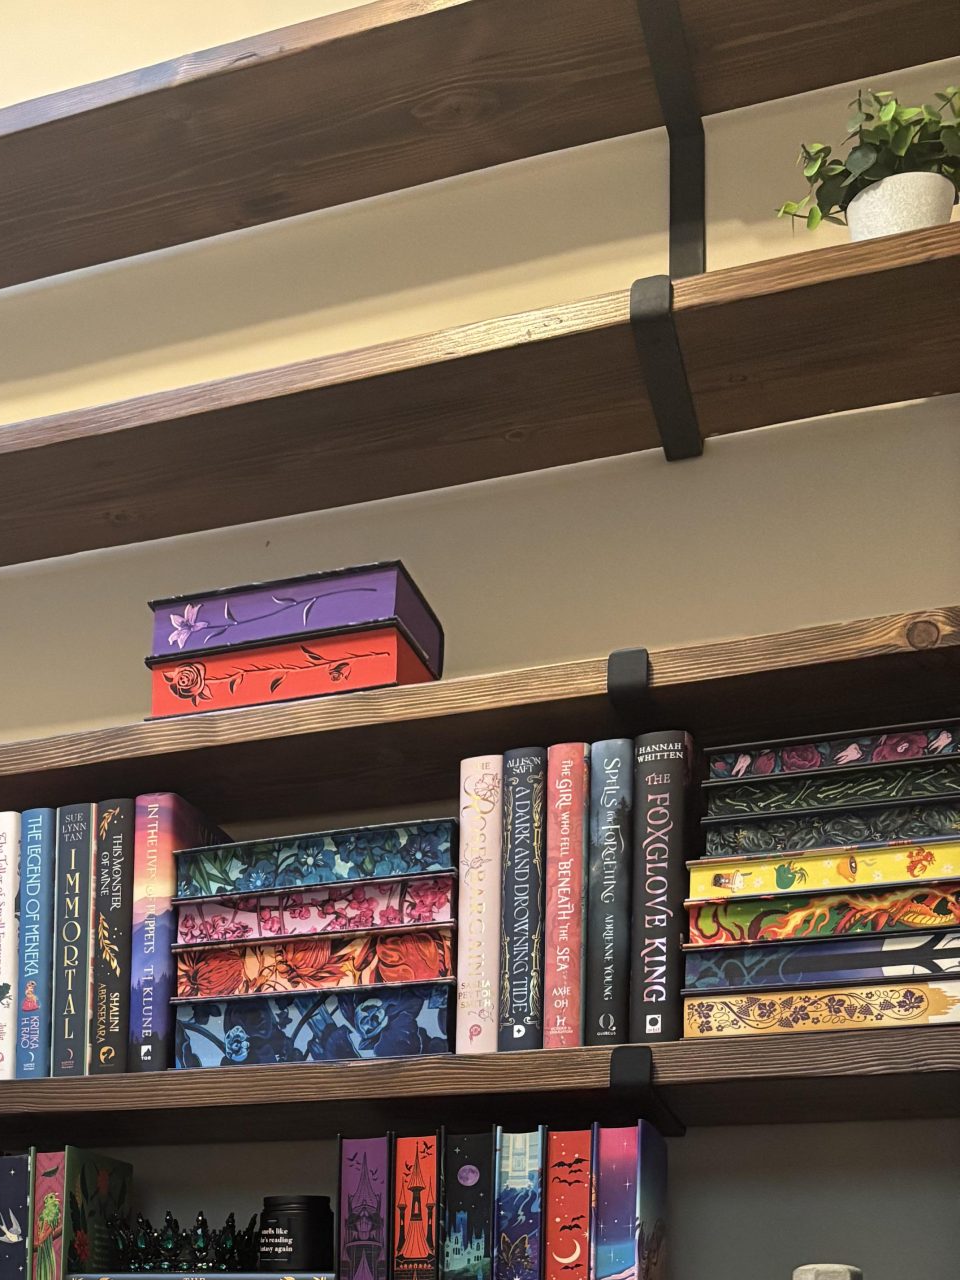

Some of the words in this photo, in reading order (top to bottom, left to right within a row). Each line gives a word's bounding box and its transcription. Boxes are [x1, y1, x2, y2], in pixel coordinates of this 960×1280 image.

[561, 760, 573, 777] THE
[601, 758, 622, 807] SPELLS
[516, 787, 529, 799] A
[556, 779, 571, 809] GIRL
[148, 804, 158, 817] IN
[515, 802, 530, 844] DARK
[559, 812, 570, 834] WHO
[28, 815, 42, 842] THE
[113, 834, 123, 856] THIS
[147, 821, 157, 847] THE
[102, 852, 110, 866] OF
[514, 848, 529, 880] AND
[559, 837, 569, 857] FELL
[642, 793, 673, 929] FOXGLOVE
[26, 845, 42, 896] LEGEND
[100, 869, 110, 896] MINE
[110, 858, 124, 911] MONSTER
[557, 858, 573, 920] BENEATH
[25, 899, 41, 921] OF
[62, 849, 81, 1039] IMMORTAL
[144, 905, 156, 953] PUPPETS
[512, 884, 529, 974] DROWNING
[559, 923, 570, 941] THE
[24, 924, 40, 977] MENEKA
[556, 946, 570, 972] SEA
[603, 965, 615, 1000] YOUNG
[640, 936, 667, 1002] KING
[110, 992, 120, 1032] SHALINI
[142, 987, 152, 1038] KLUNE
[512, 977, 528, 1014] TIDE
[96, 983, 108, 1043] ABEYSEKARA
[30, 1015, 40, 1049] KRITIKA
